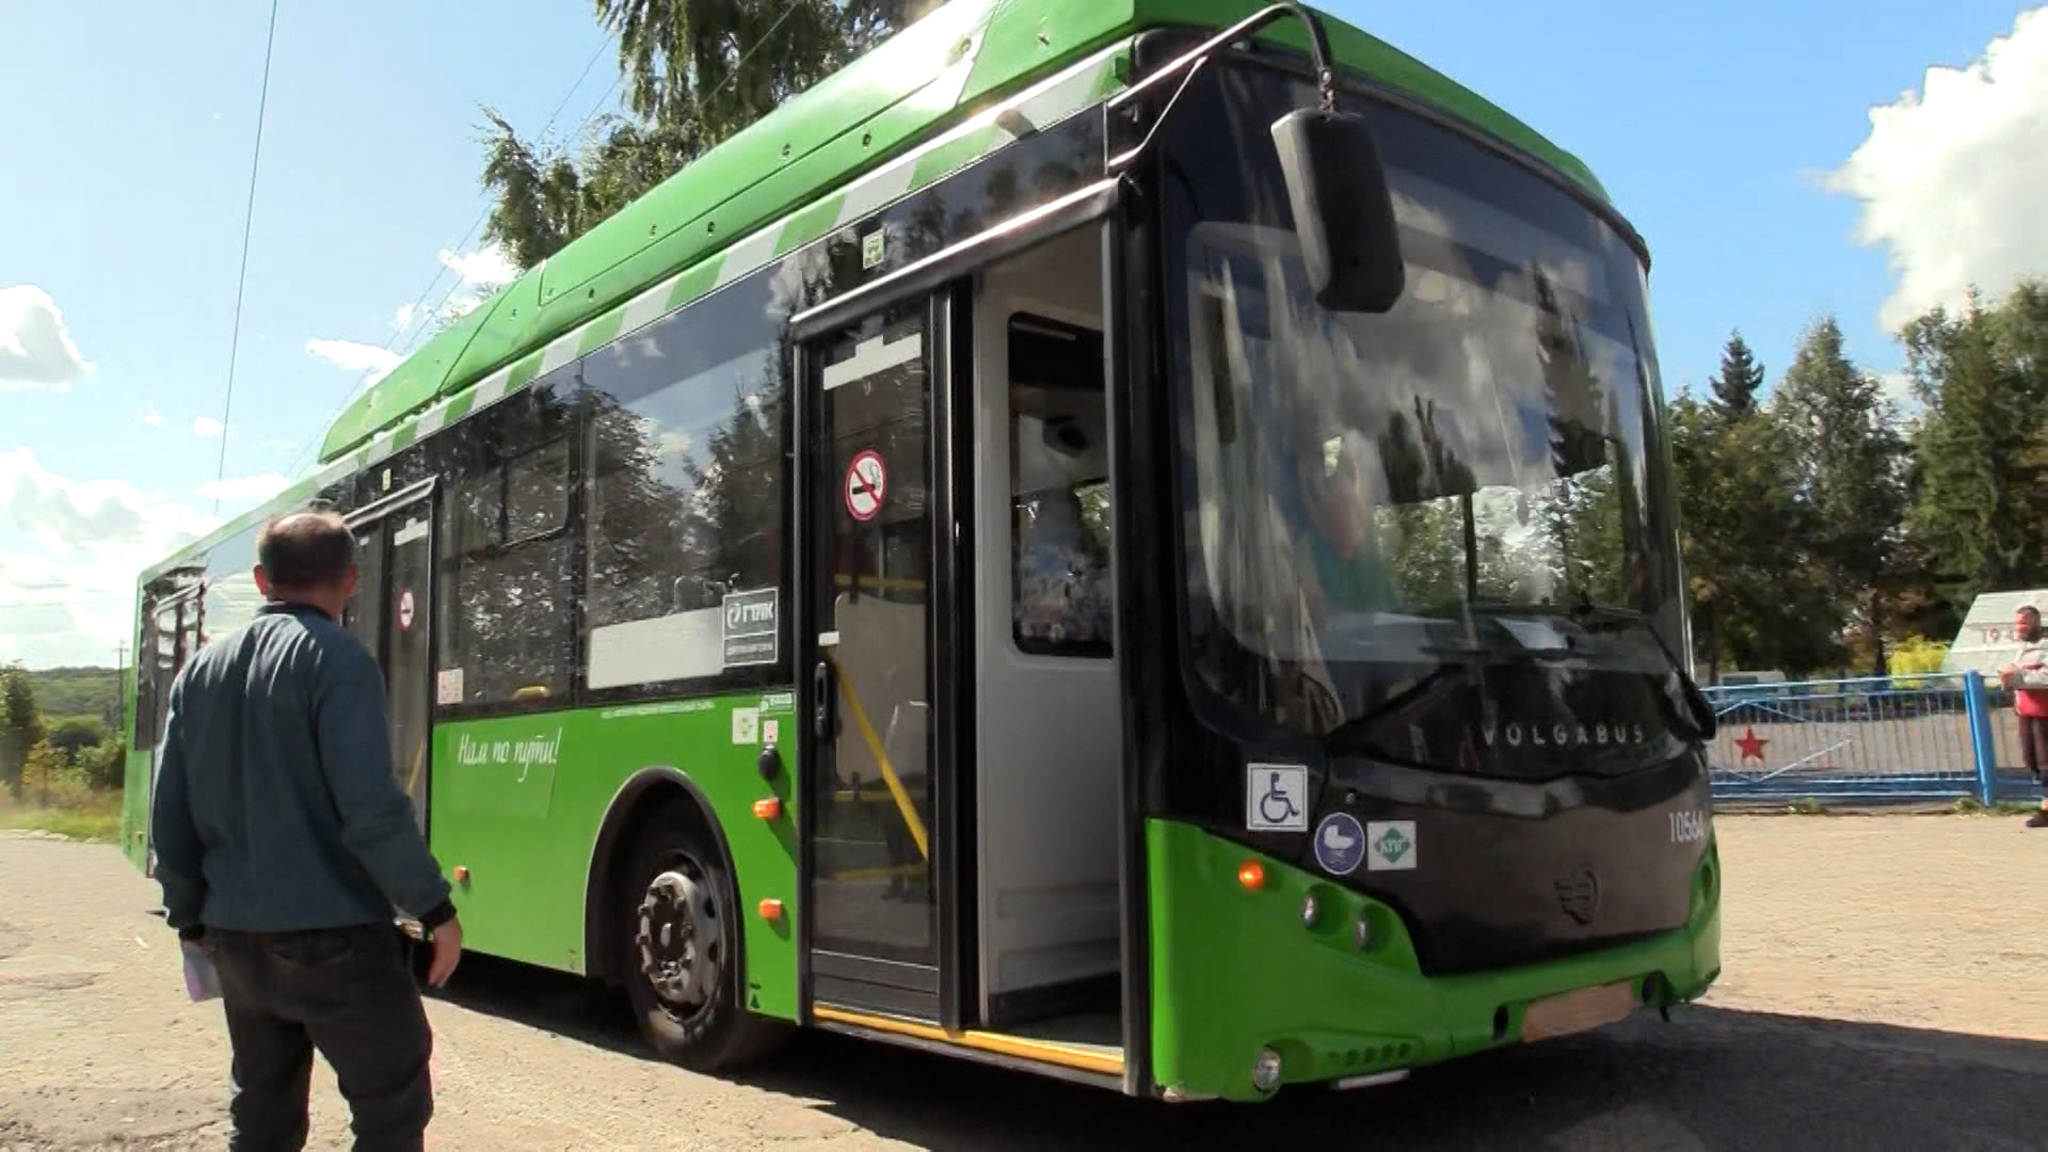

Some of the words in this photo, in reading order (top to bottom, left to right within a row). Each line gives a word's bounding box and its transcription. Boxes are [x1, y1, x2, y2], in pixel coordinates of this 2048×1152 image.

[458, 733, 489, 765] Нам
[493, 741, 510, 764] по
[514, 727, 562, 783] пути!
[1484, 724, 1644, 747] VOLGABUS
